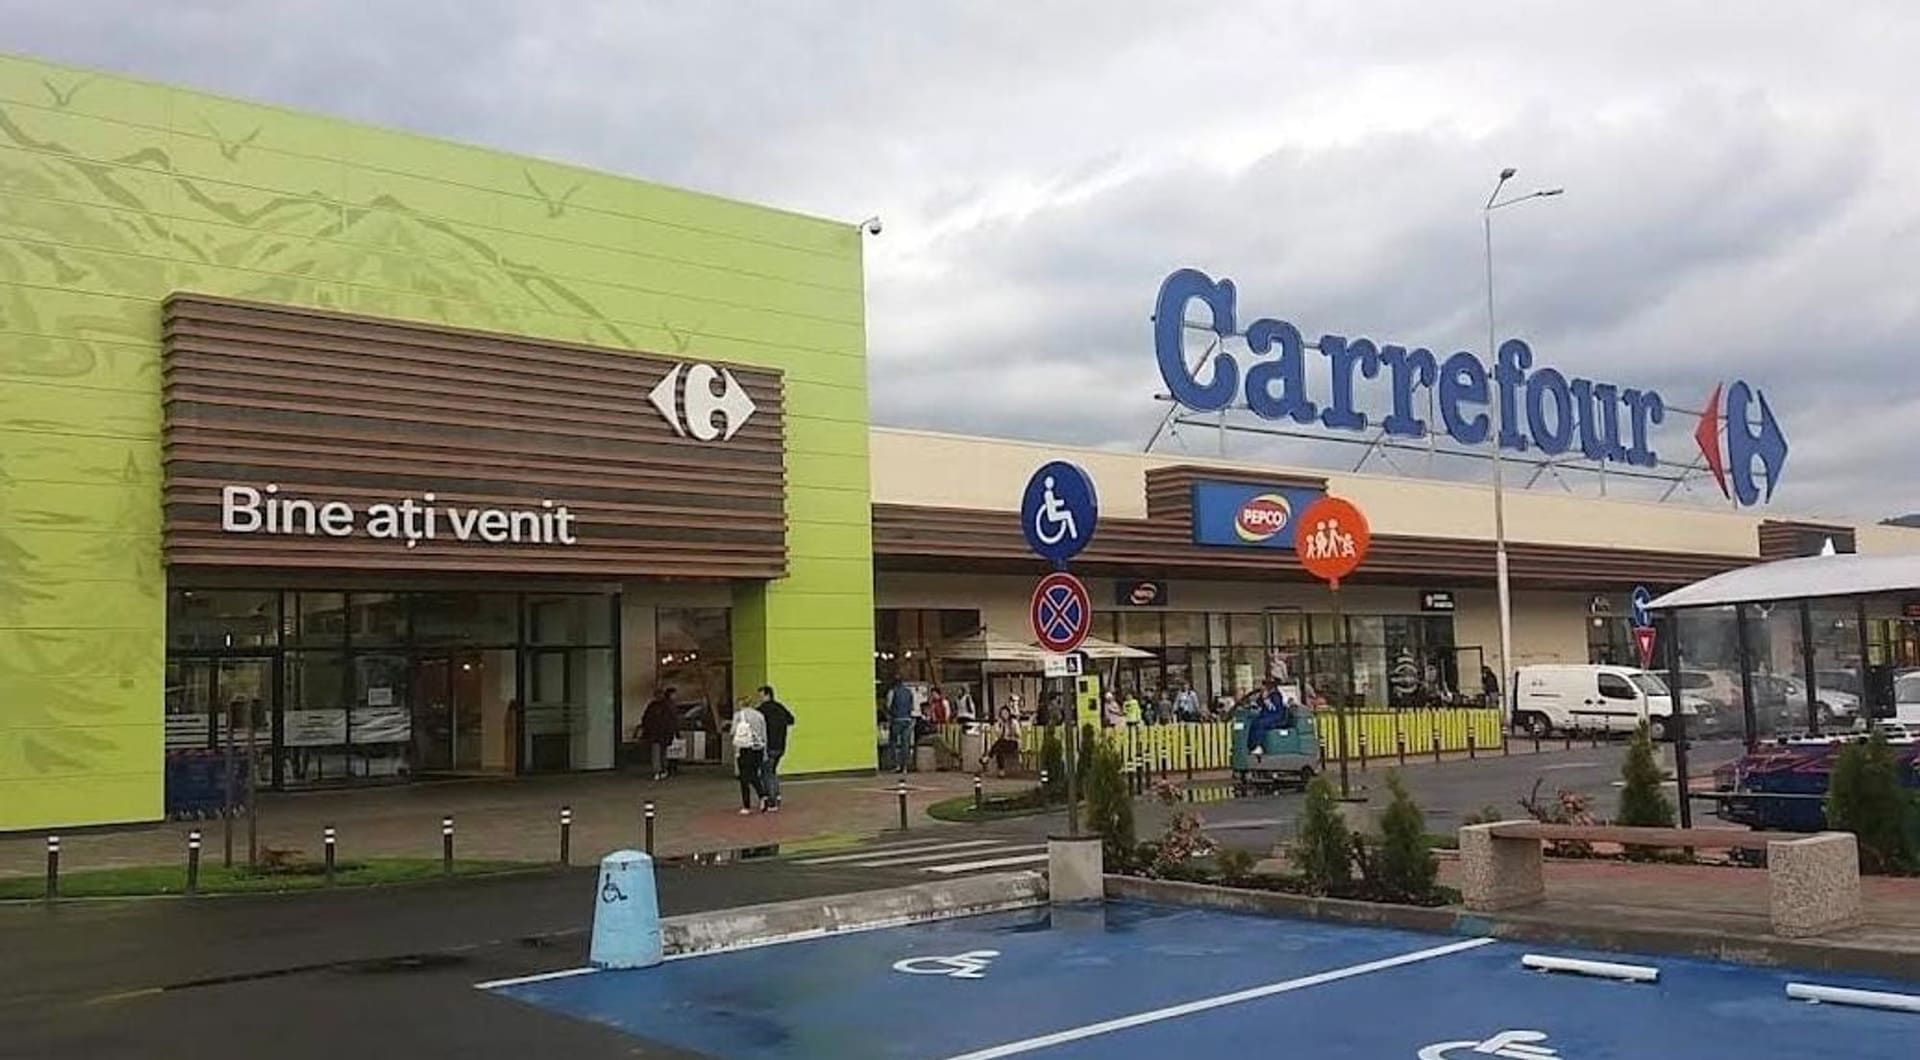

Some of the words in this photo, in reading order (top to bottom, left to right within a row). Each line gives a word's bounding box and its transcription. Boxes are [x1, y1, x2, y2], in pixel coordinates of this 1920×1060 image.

[1154, 268, 1664, 468] Carrefour
[221, 484, 354, 536] Bine
[366, 493, 435, 548] ați
[448, 500, 576, 545] venit
[1243, 508, 1283, 526] PEPCO
